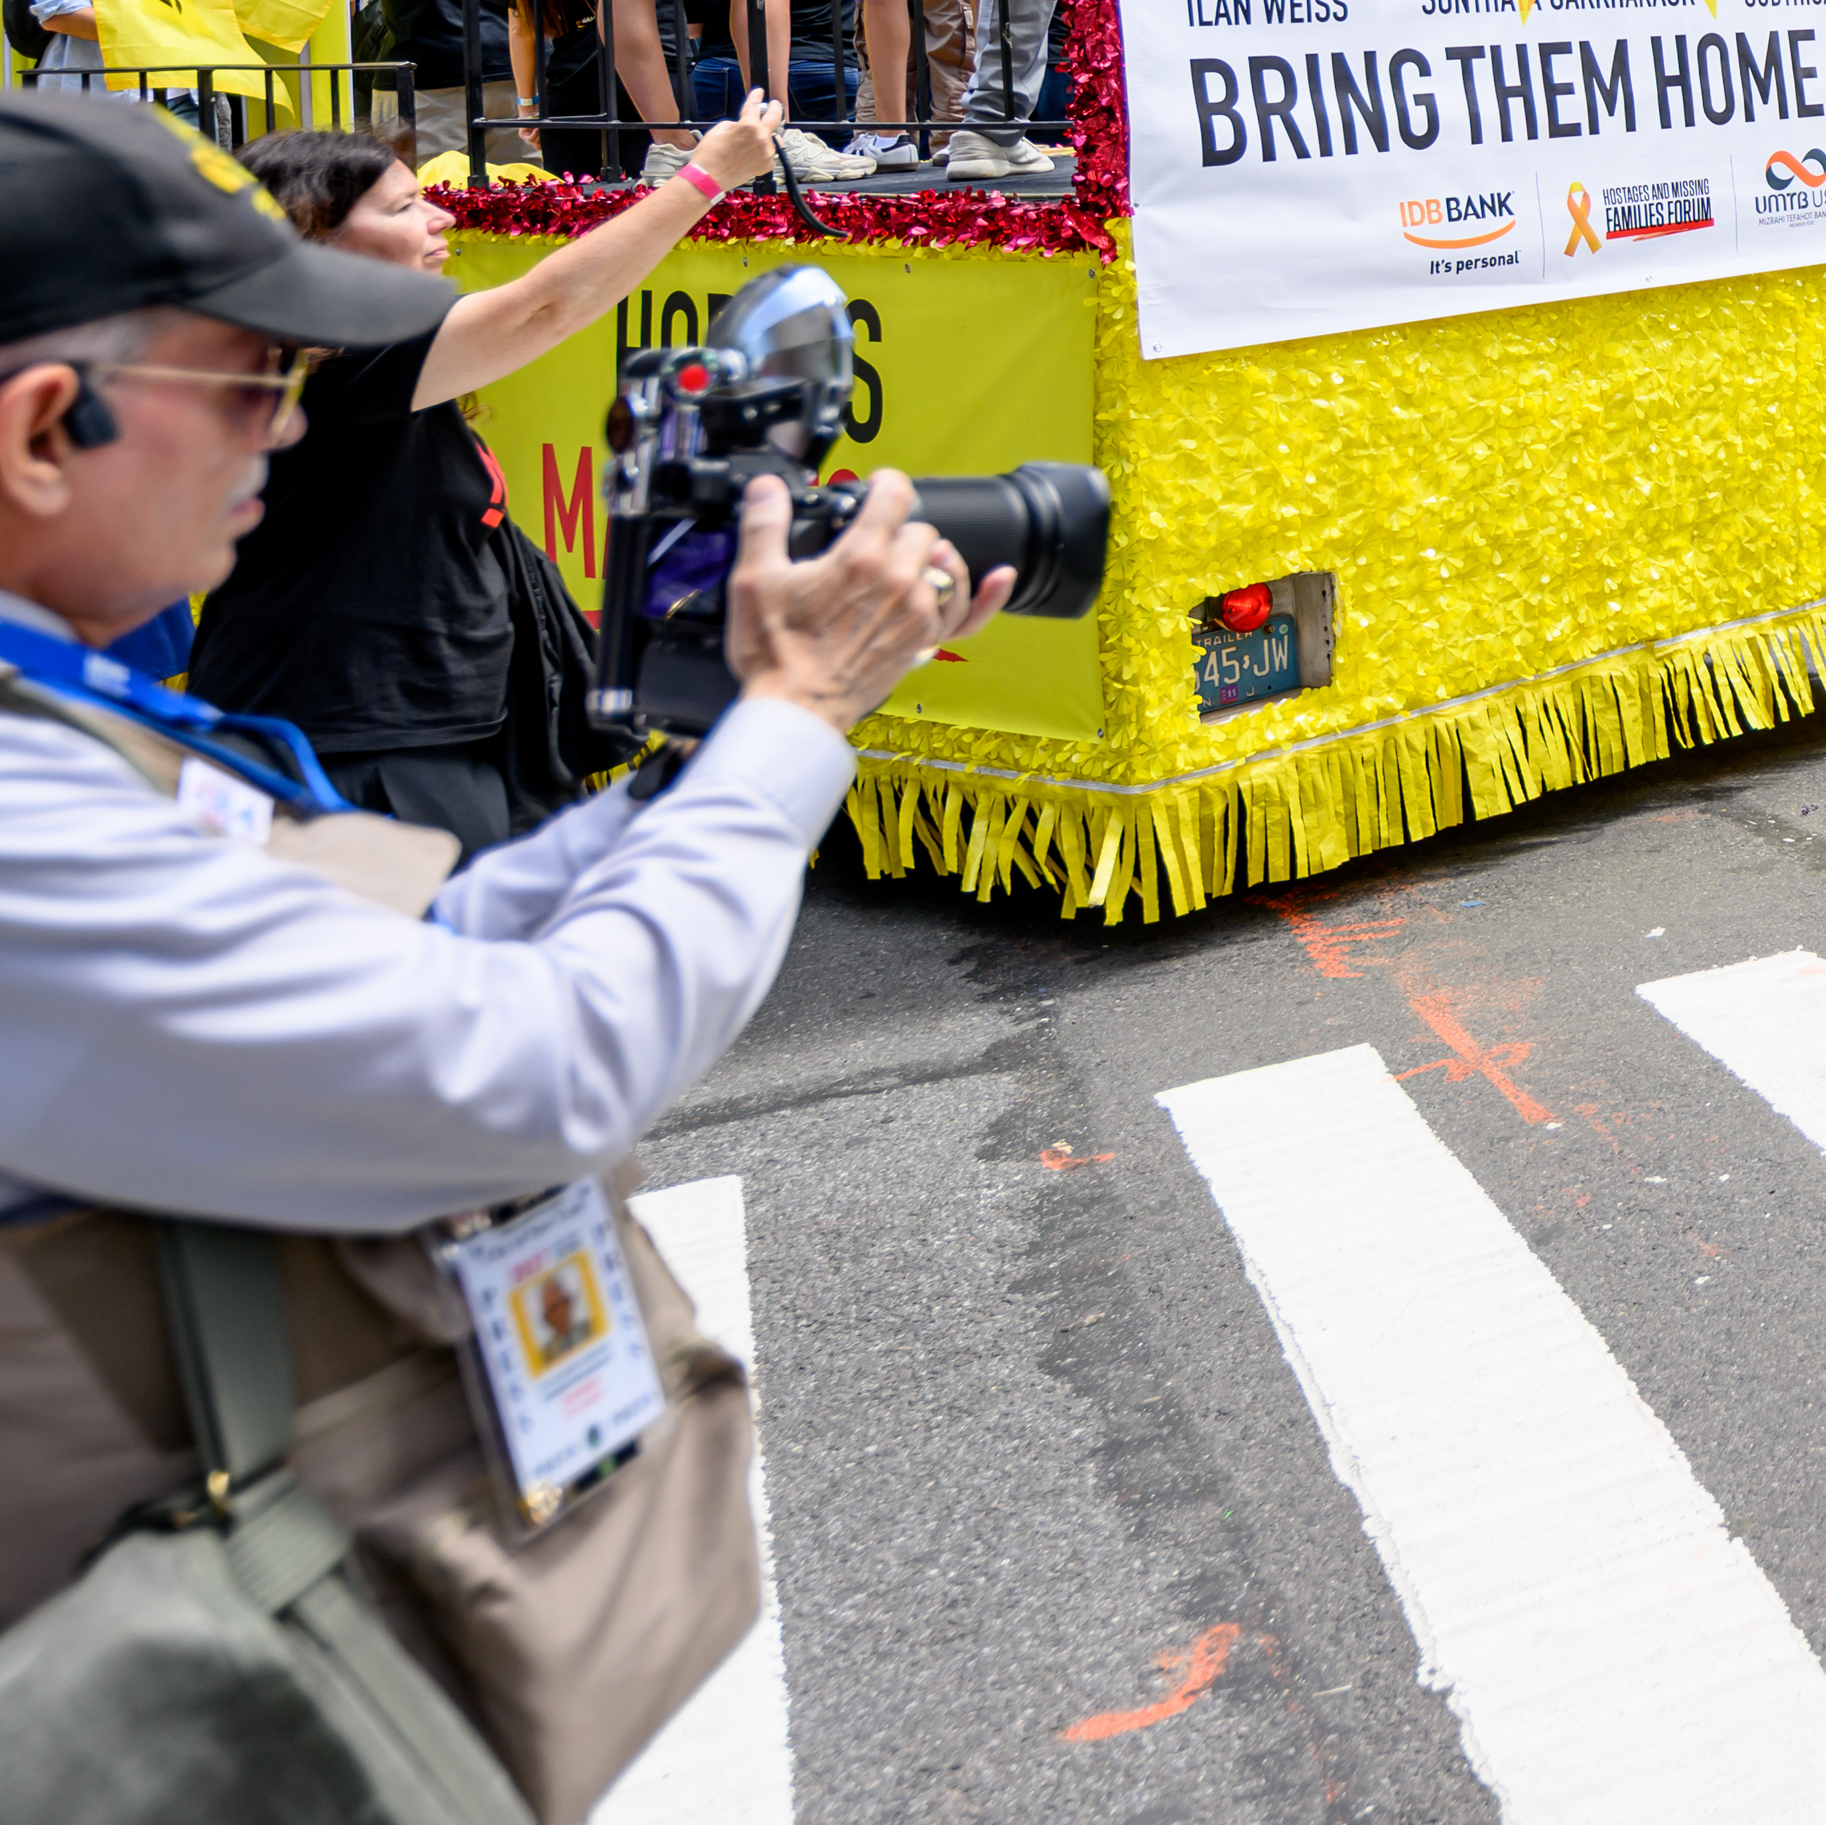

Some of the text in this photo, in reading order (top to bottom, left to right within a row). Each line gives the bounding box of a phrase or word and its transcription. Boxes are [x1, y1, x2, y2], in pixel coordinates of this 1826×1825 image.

[1191, 47, 1440, 168] BRING
[1445, 37, 1639, 147] THEM
[1651, 28, 1826, 130] HOME
[1602, 178, 1710, 206] HOSTAGES AND MISSING
[1399, 191, 1514, 228] IDB BANK
[1605, 197, 1712, 233] FAMILIES FORUM
[1758, 216, 1785, 227] MIZRAHI
[1786, 212, 1814, 225] TEFAHOT
[1430, 250, 1520, 275] It's personal
